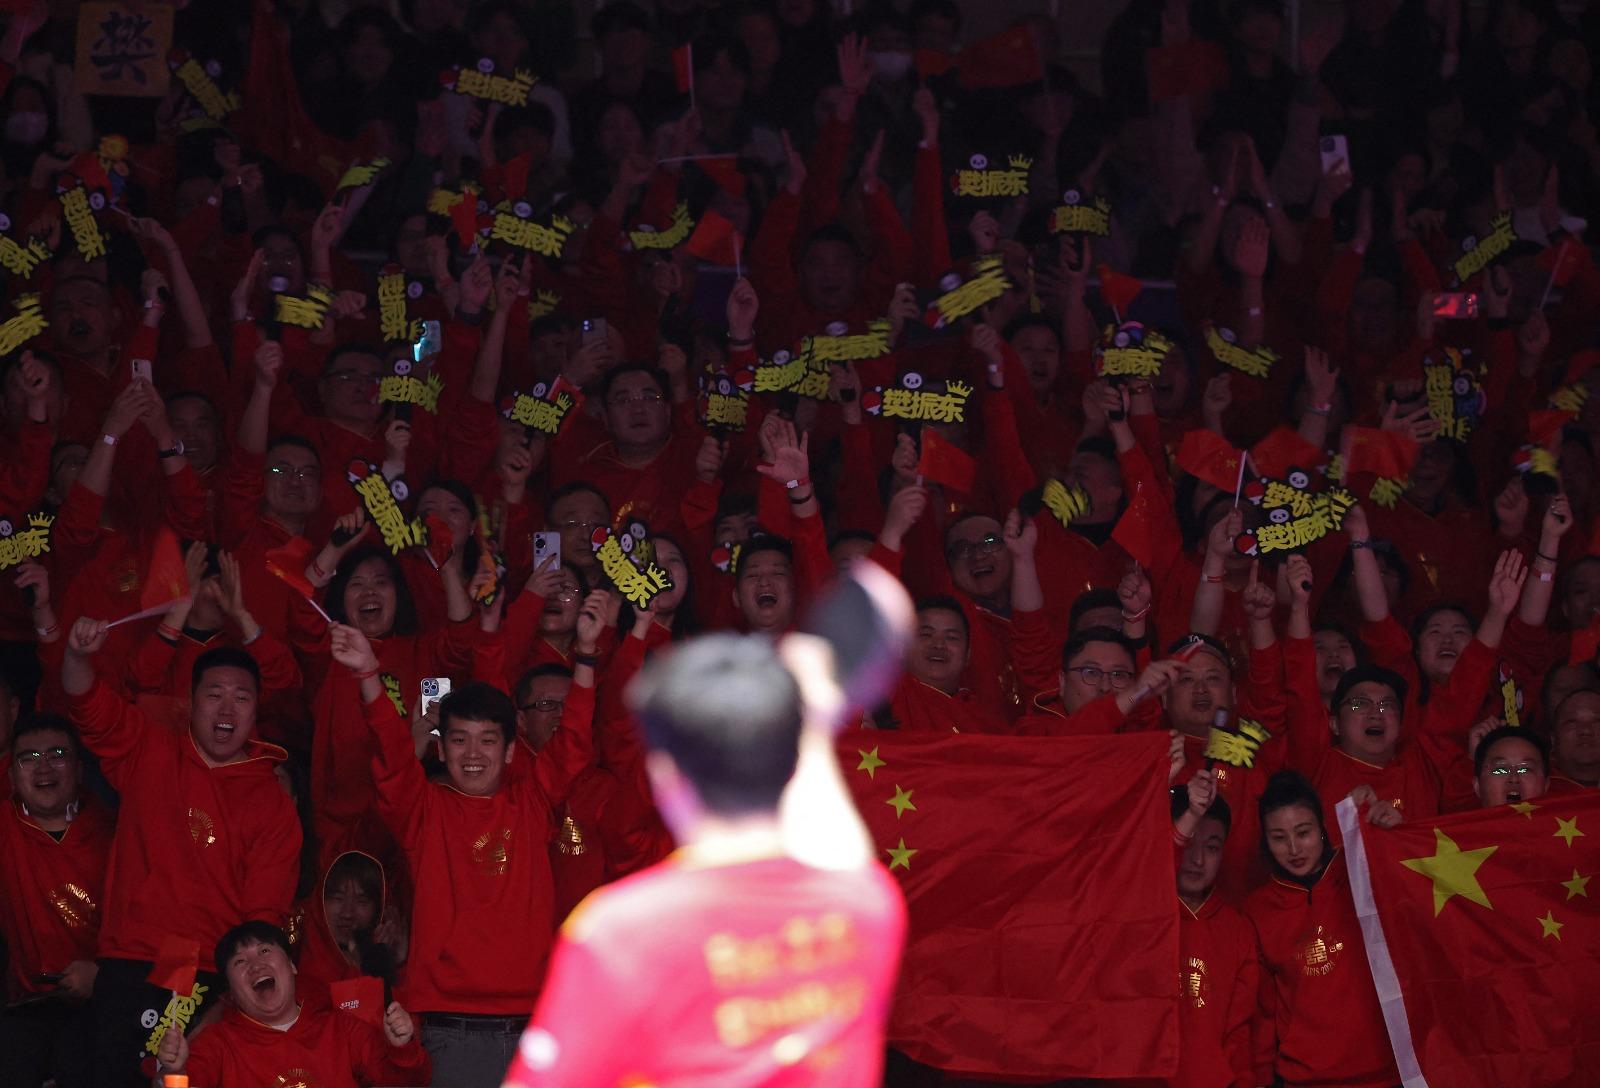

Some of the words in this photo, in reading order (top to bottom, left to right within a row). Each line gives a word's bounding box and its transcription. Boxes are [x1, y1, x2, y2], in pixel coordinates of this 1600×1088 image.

[960, 170, 1029, 196] 樊振东
[882, 388, 967, 423] 樊振东
